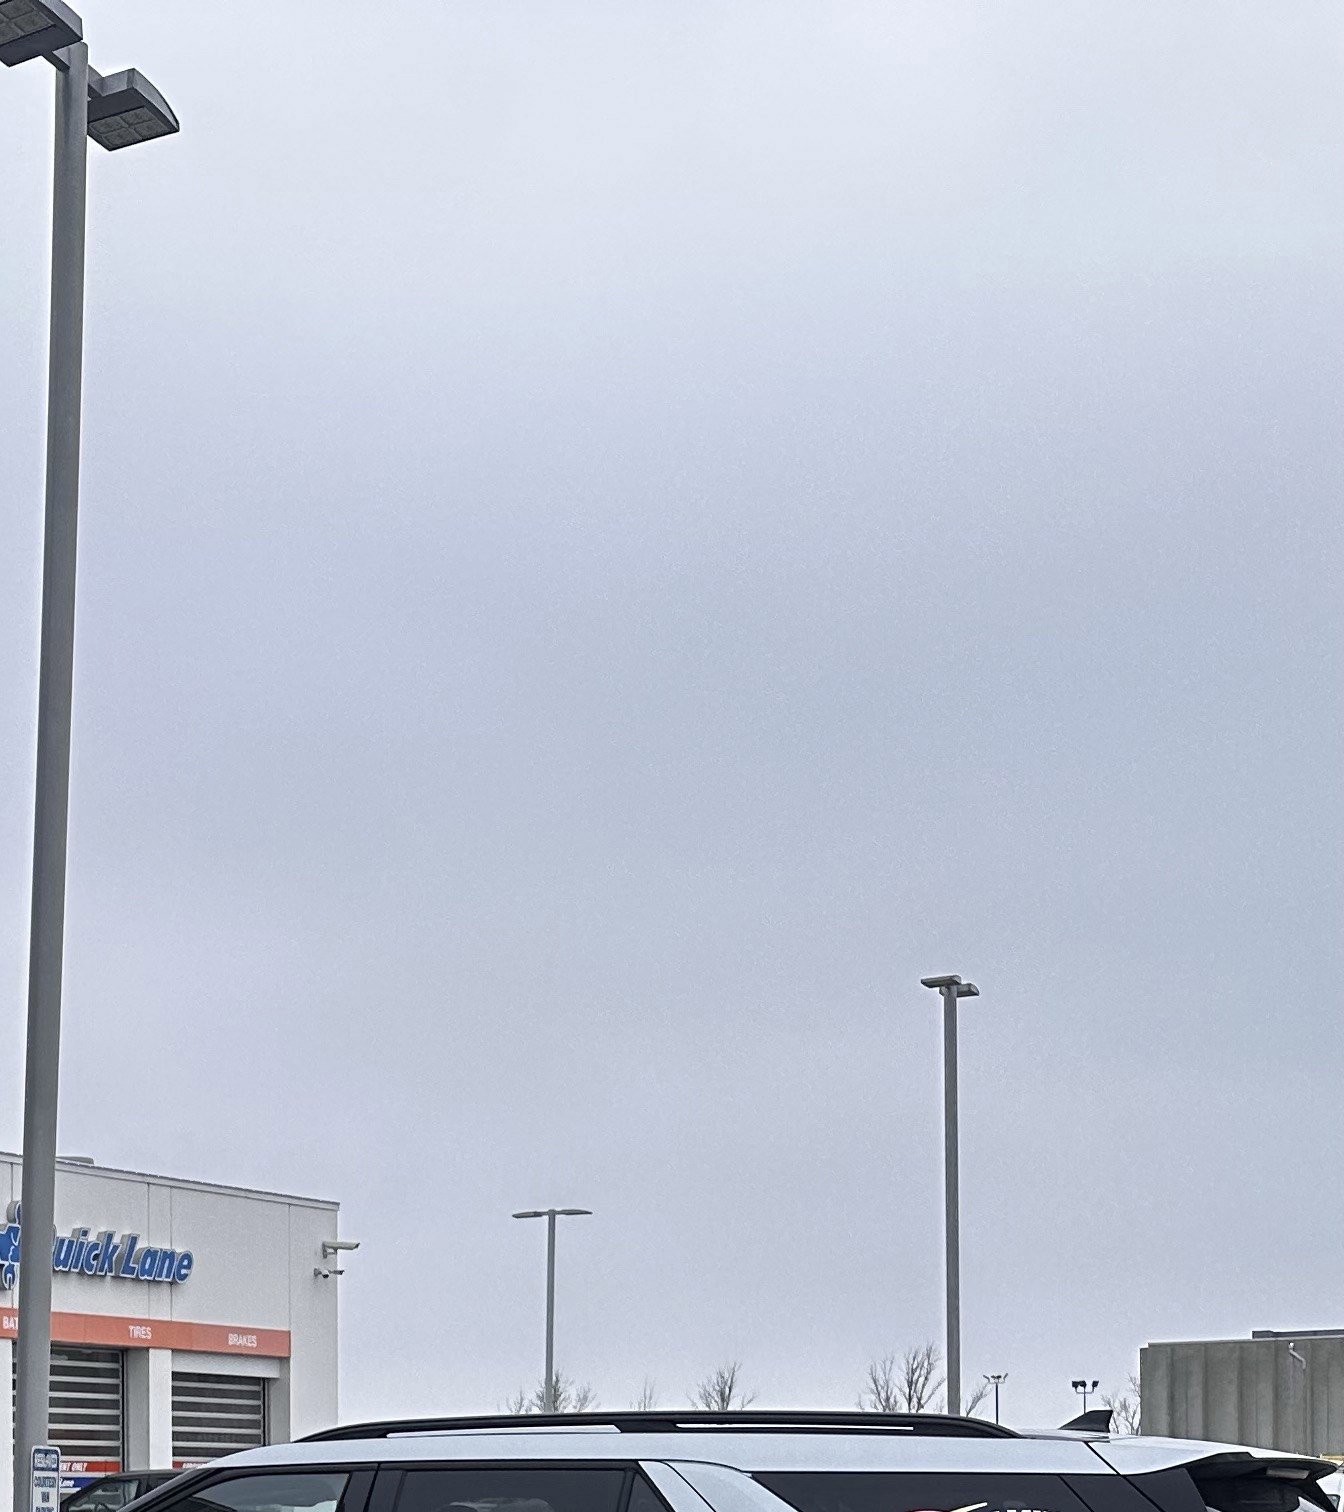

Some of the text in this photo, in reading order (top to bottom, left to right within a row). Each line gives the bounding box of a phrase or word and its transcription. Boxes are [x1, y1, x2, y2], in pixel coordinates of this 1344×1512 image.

[52, 1227, 194, 1284] uick Lane
[128, 1325, 153, 1340] TIRES
[228, 1333, 258, 1348] BRAKES
